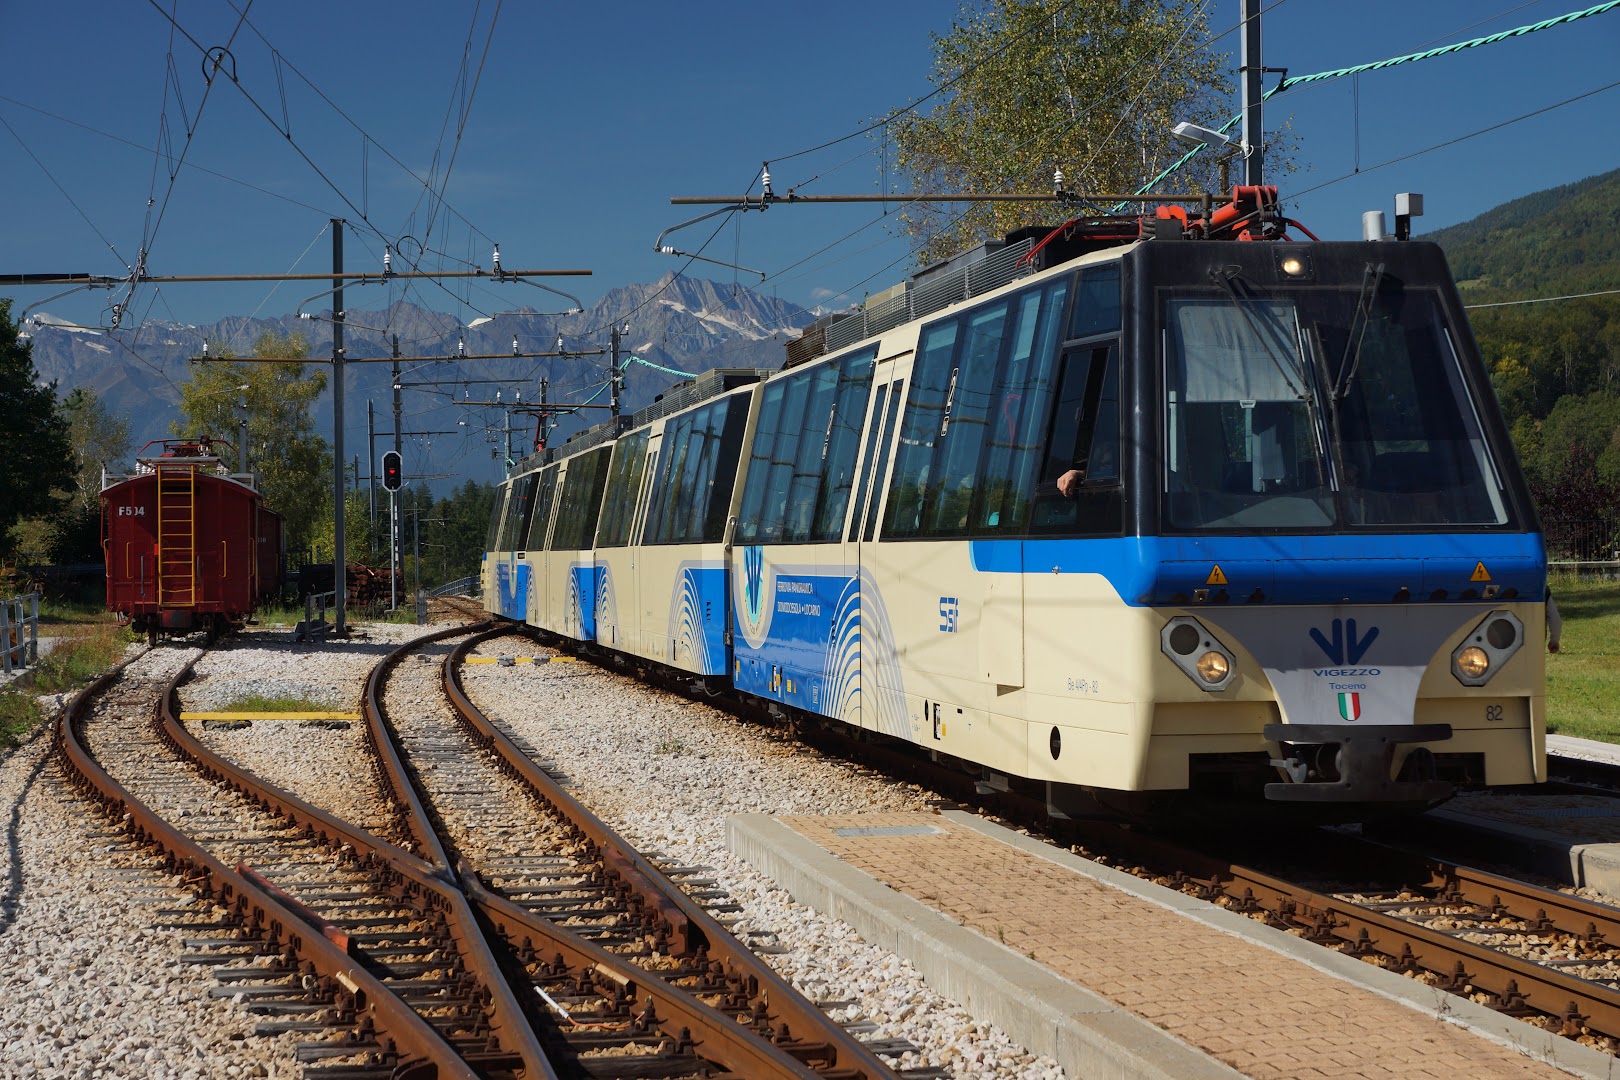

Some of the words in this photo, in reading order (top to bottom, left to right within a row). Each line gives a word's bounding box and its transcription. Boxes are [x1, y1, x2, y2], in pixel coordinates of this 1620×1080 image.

[804, 604, 820, 616] LOCARNO
[1313, 668, 1380, 676] VIGEZZO
[1486, 705, 1504, 721] 82
